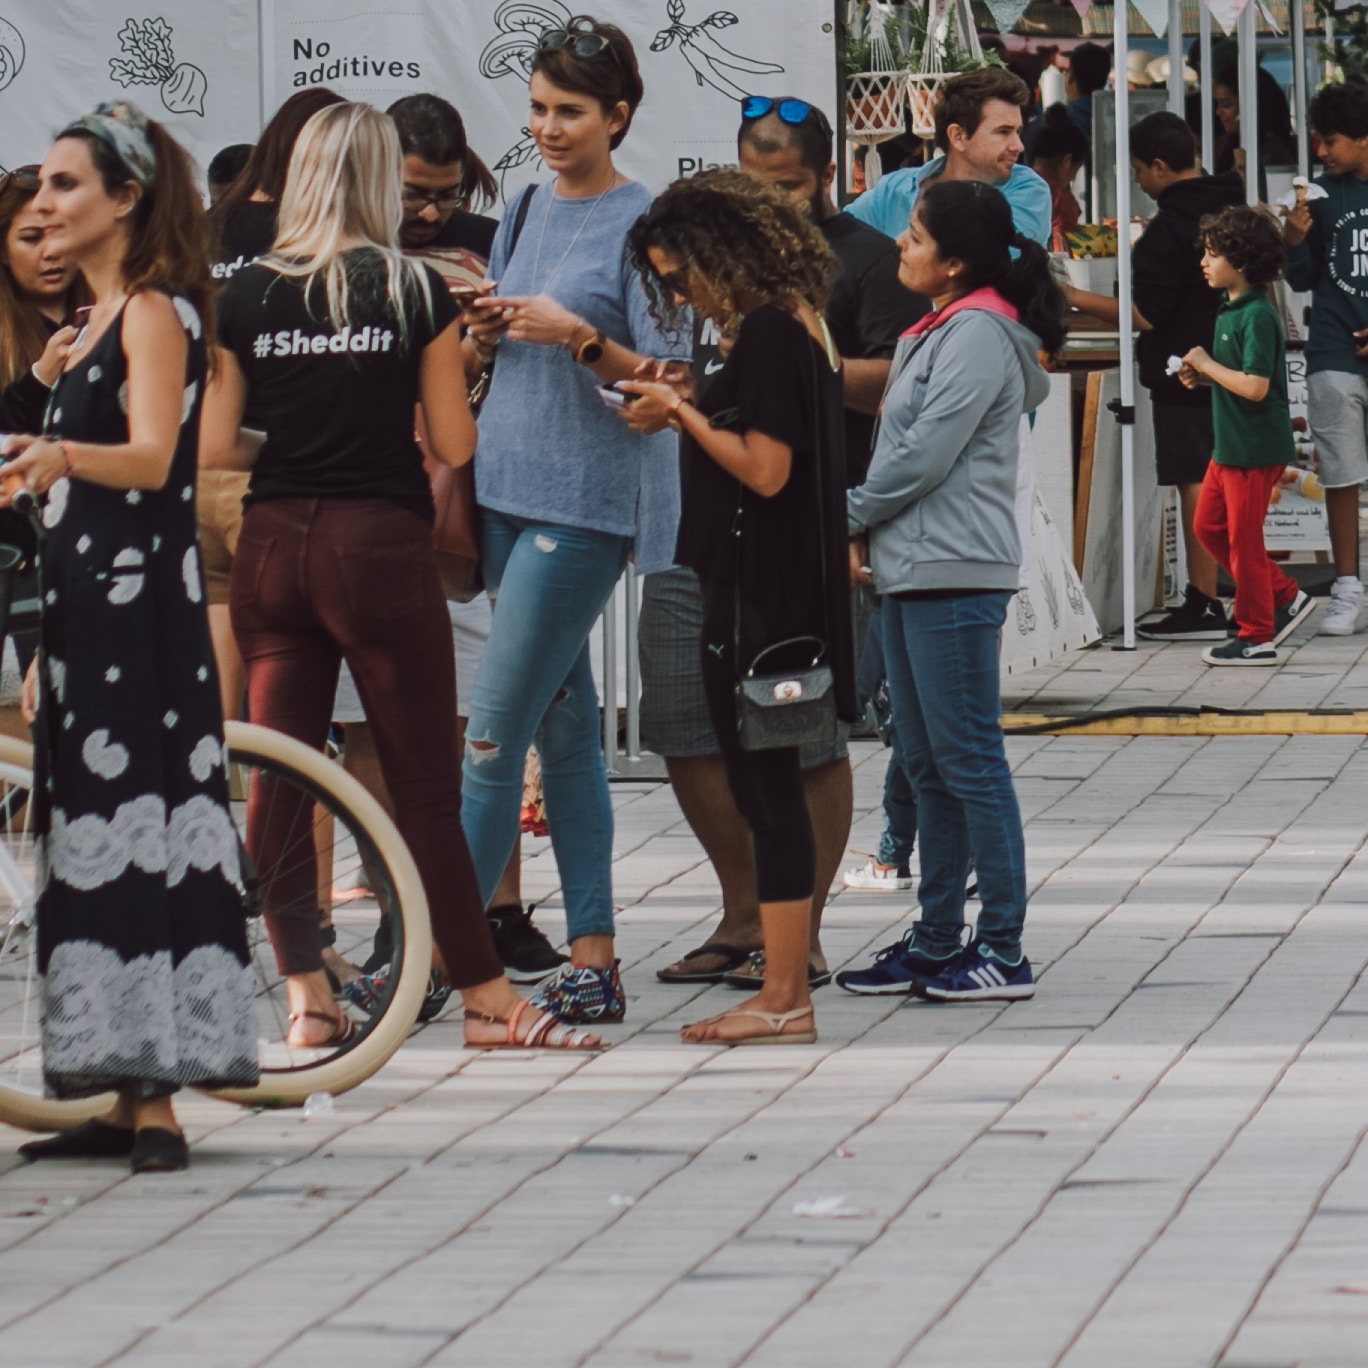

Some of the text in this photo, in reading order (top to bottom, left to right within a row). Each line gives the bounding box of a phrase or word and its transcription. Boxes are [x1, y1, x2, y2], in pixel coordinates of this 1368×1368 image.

[293, 38, 331, 61] No
[293, 55, 421, 87] additives
[253, 326, 394, 358] #Sheddit
